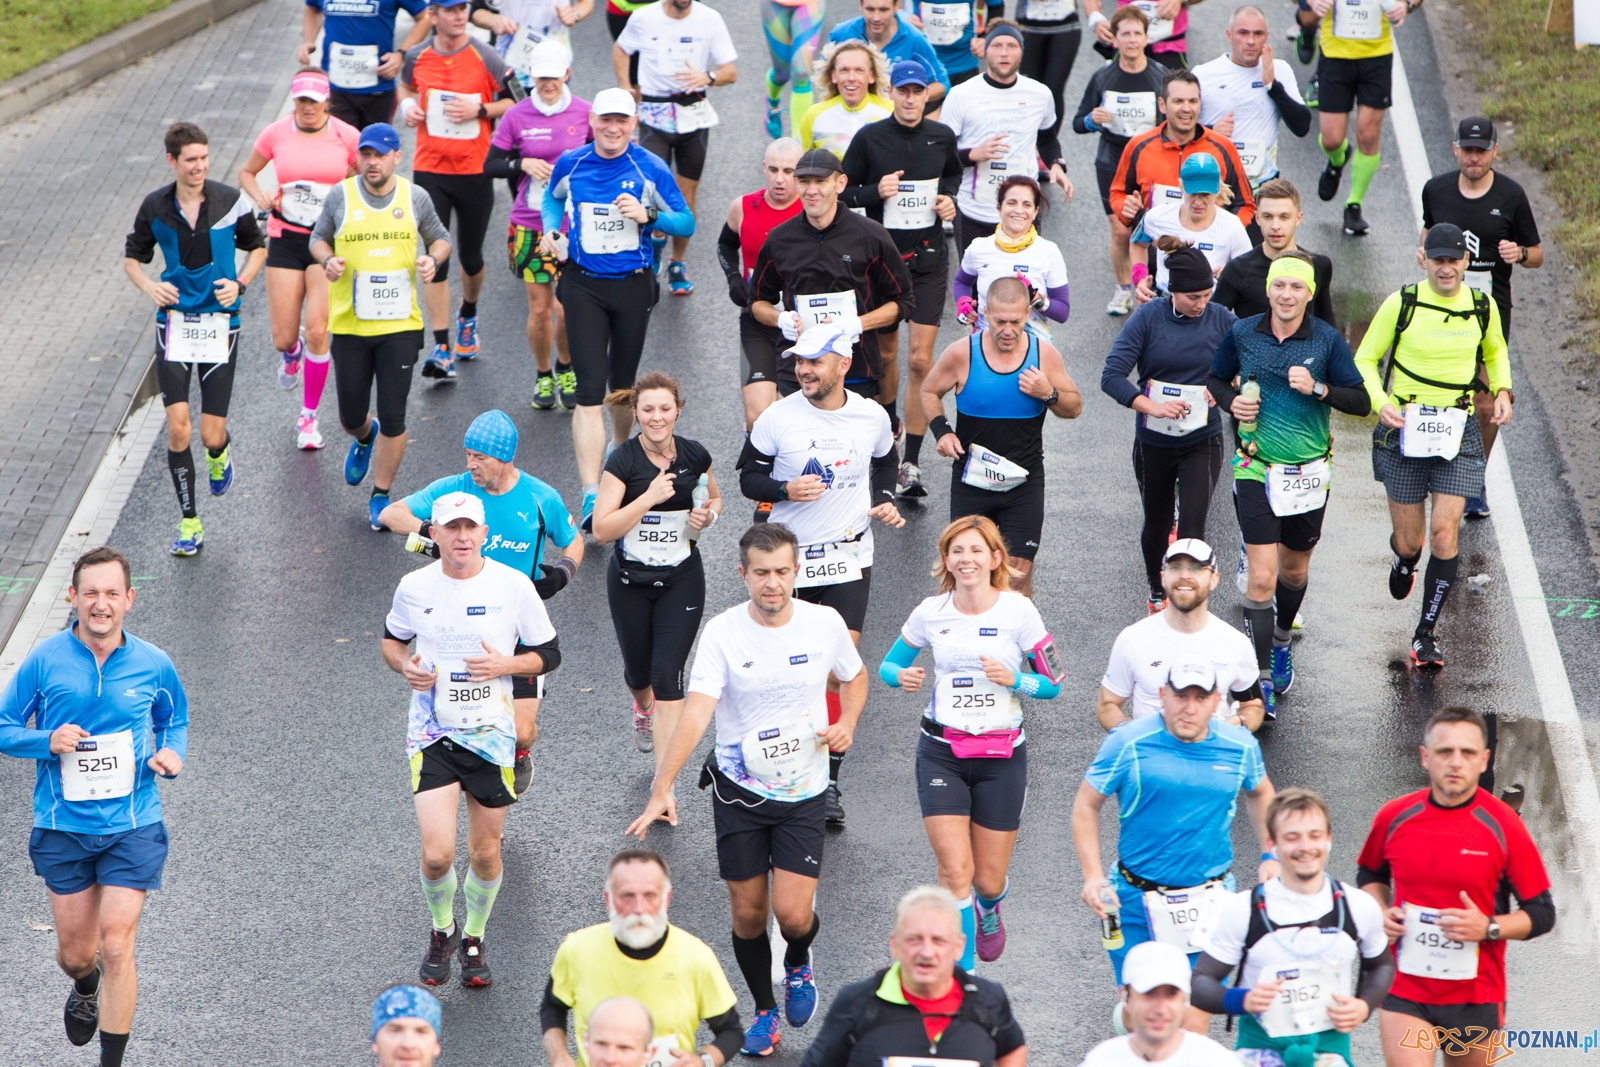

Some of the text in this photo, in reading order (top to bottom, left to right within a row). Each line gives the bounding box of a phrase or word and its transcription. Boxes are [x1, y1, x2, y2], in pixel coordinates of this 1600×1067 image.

[1350, 10, 1368, 20] 719
[338, 59, 369, 72] 5586
[1237, 155, 1257, 166] 57
[897, 196, 928, 208] 4614
[593, 220, 625, 232] 1423
[345, 230, 411, 242] LUBOŃ BIEGA
[372, 287, 399, 299] 806
[182, 327, 217, 340] 3834
[1416, 421, 1452, 437] 4684
[984, 467, 1006, 482] 1110
[175, 465, 192, 511] Kalenji
[1282, 477, 1321, 492] 2490
[639, 530, 679, 544] 5825
[501, 541, 531, 552] RUN
[805, 560, 848, 579] 6466
[1424, 578, 1450, 622] Kalenji
[435, 625, 455, 634] SIŁA
[441, 633, 483, 642] ODWAGA
[759, 676, 779, 686] SIŁA
[765, 681, 808, 693] ODWAGA
[449, 685, 491, 702] 3808
[952, 693, 996, 709] 2255
[961, 710, 987, 718] Monika
[761, 738, 801, 760] 1232
[78, 756, 118, 773] 5251
[773, 757, 795, 767] Marek
[85, 774, 113, 783] Szymon
[1169, 907, 1200, 926] 180
[1281, 983, 1321, 1005] 3162
